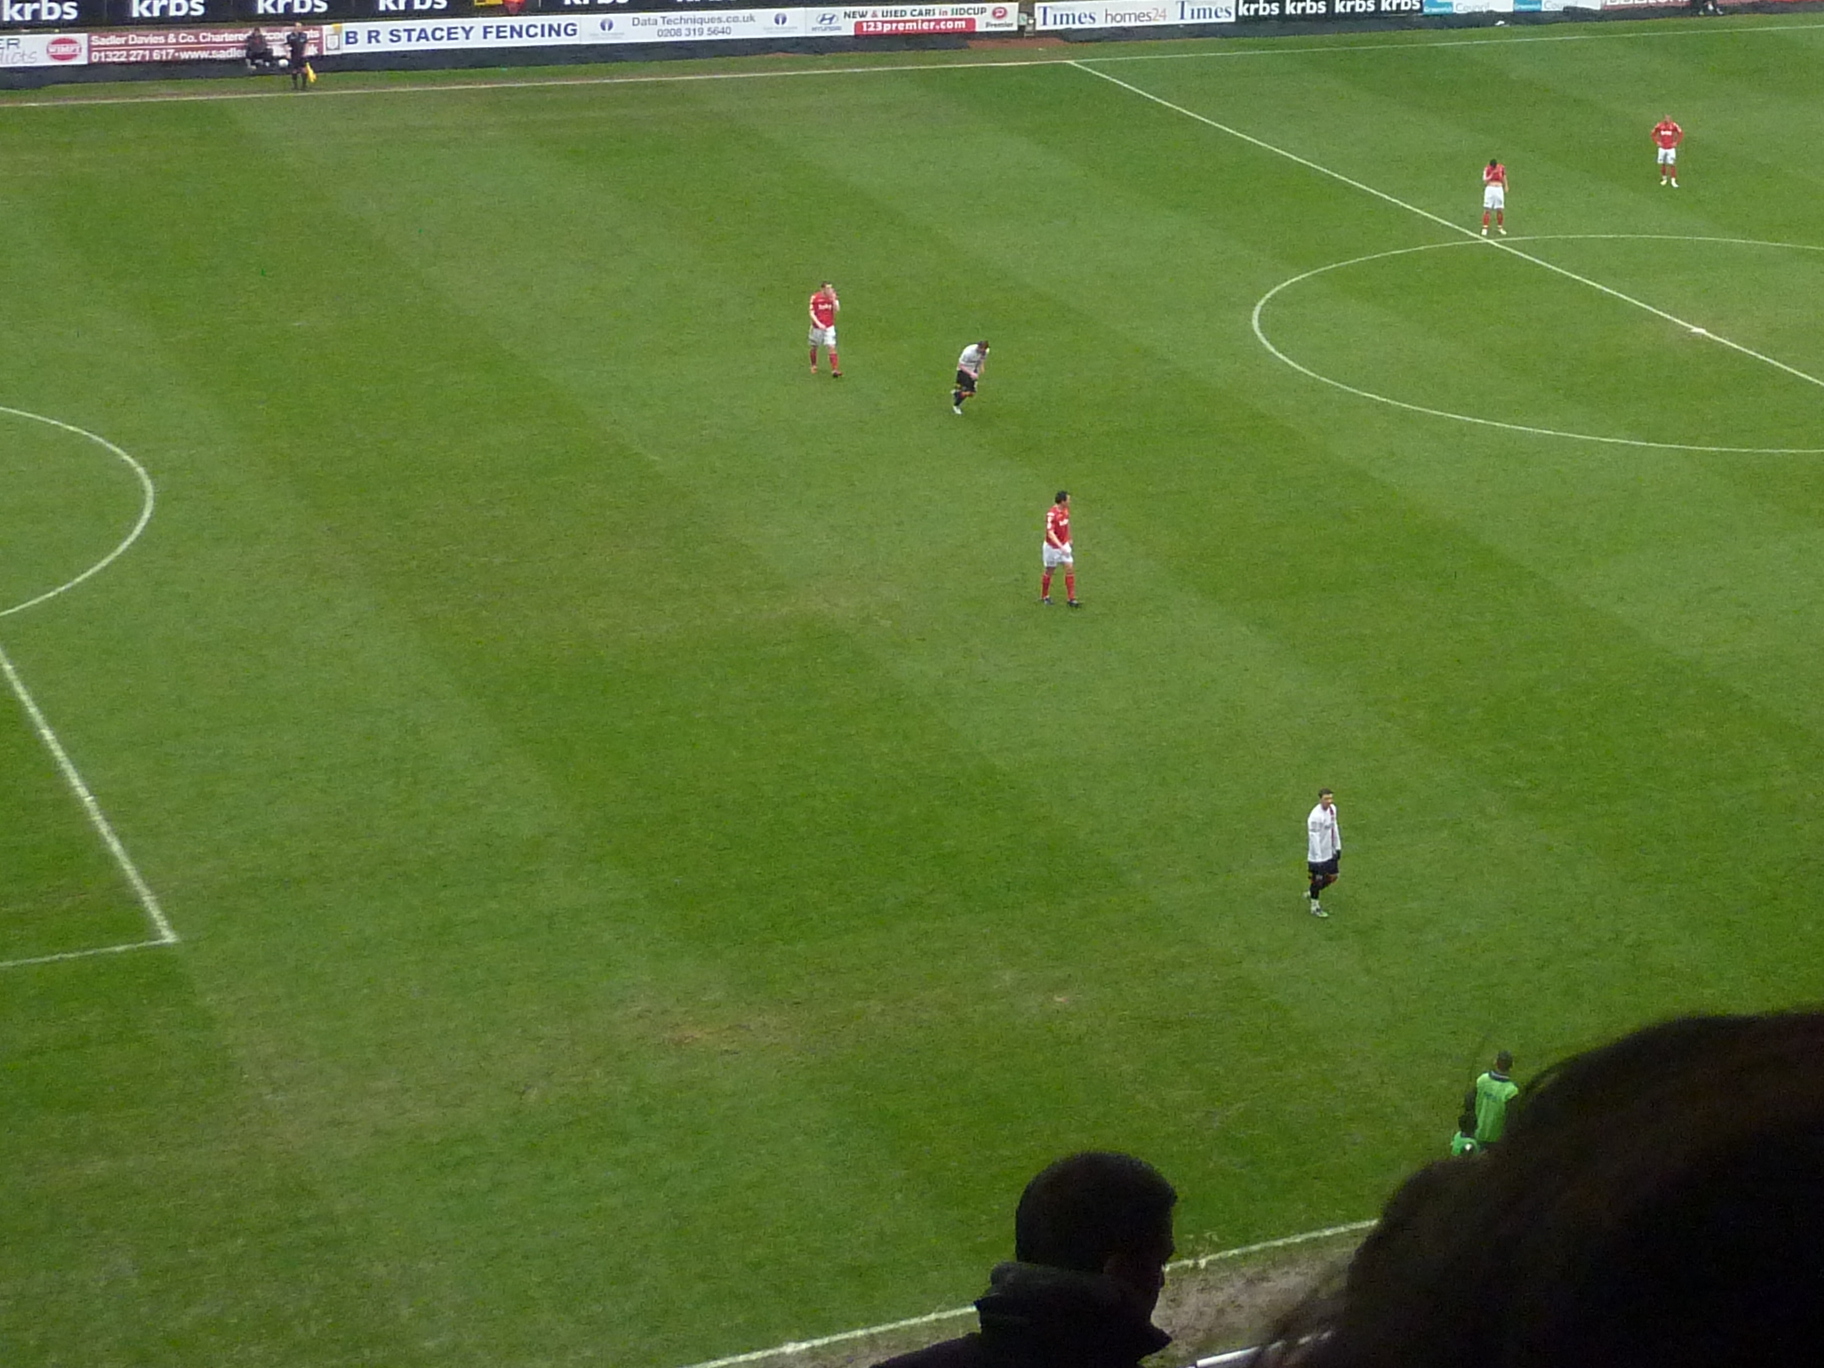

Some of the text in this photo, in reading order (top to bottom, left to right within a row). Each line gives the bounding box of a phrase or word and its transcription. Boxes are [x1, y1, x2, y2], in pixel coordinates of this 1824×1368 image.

[843, 11, 868, 19] NEW
[881, 9, 907, 18] USED
[910, 8, 936, 18] CARS
[951, 7, 987, 17] SIDCUP
[1037, 5, 1097, 27] Times
[1175, 0, 1233, 21] Times
[632, 17, 658, 27] Data
[861, 18, 967, 33] 123premier.com
[91, 35, 127, 46] Sadler
[128, 33, 165, 45] Davies
[178, 32, 197, 44] Co.
[345, 30, 359, 45] B
[367, 29, 382, 44] R
[389, 25, 476, 44] STACEY
[482, 22, 578, 40] FENCING
